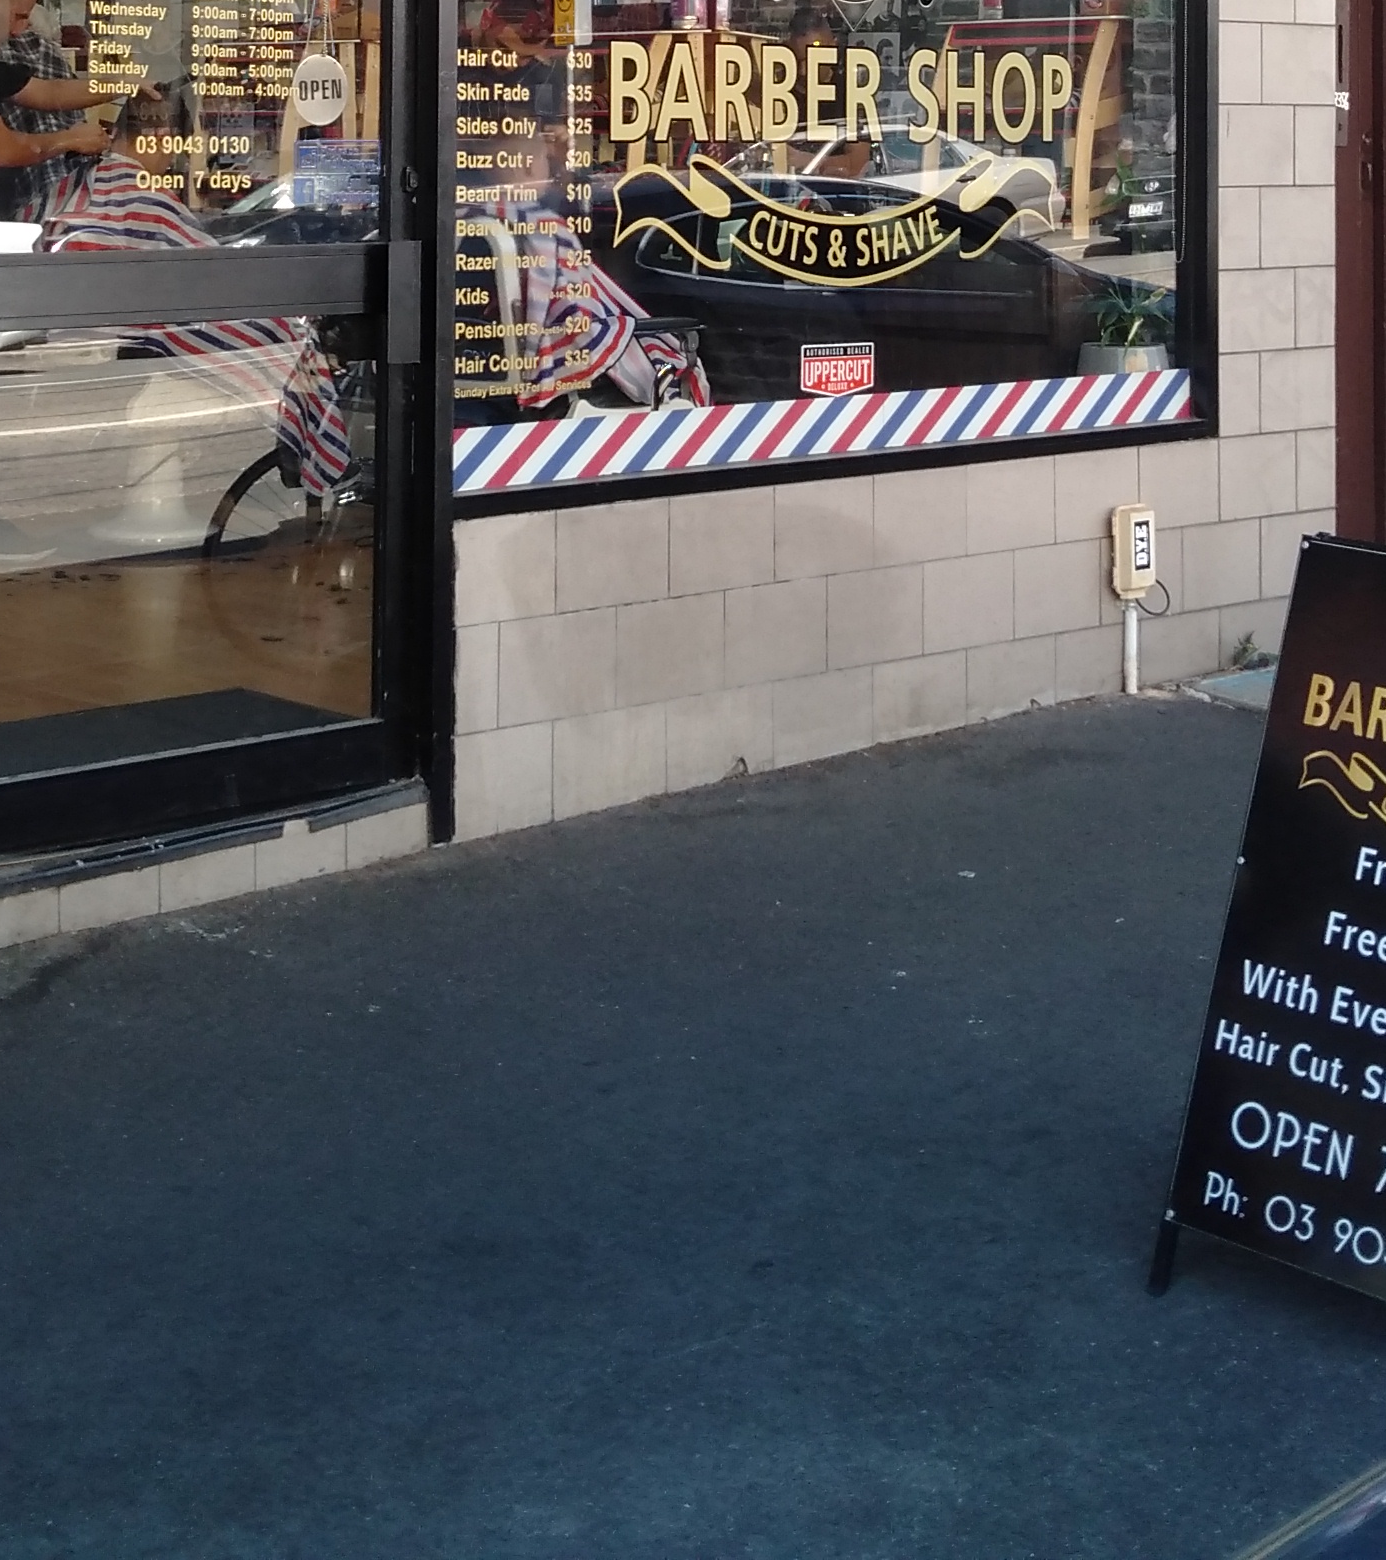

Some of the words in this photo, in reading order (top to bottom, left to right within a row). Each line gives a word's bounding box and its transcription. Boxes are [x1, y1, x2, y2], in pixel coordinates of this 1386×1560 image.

[90, 1, 166, 21] Wednesday
[90, 21, 152, 39] Thursday
[90, 40, 131, 56] Friday
[457, 49, 488, 67] Hair
[492, 50, 518, 67] Cut
[566, 52, 592, 69] $30
[90, 60, 148, 78] Saturday
[192, 63, 237, 77] 9:00am
[249, 64, 293, 80] 5:00pm
[89, 80, 139, 97] Sunday
[192, 83, 244, 96] 10:00am
[255, 84, 300, 100] 4:00pm
[299, 79, 342, 101] OPEN
[456, 83, 489, 101] Skin
[494, 83, 530, 101] Fade
[567, 85, 592, 103] $35
[609, 40, 881, 144] BARBER
[908, 49, 1074, 144] SHOP
[456, 117, 498, 134] Sides
[502, 117, 536, 138] Only
[567, 117, 592, 135] $25
[136, 135, 156, 154] 03
[163, 136, 203, 156] 9043
[209, 136, 250, 155] 0130
[456, 151, 492, 168] Buzz
[497, 151, 523, 168] Cut
[566, 150, 591, 168] $20
[136, 171, 184, 192] Open
[195, 172, 204, 188] 7
[210, 171, 252, 193] days
[456, 185, 500, 203] Beard
[504, 185, 537, 201] Trim
[567, 183, 591, 202] $10
[748, 210, 819, 267] CUTS
[827, 238, 847, 268] &
[856, 204, 944, 267] SHAVE
[455, 288, 489, 305] Kids
[566, 283, 591, 299] $20
[455, 320, 538, 340] Pensioners
[565, 316, 590, 335] $20
[806, 347, 844, 356] AUTHORISED
[847, 346, 870, 355] DEALER
[455, 357, 486, 374] Hair
[489, 354, 539, 372] Colour
[565, 350, 590, 366] $35
[804, 359, 870, 386] UPPERCUT
[1243, 959, 1318, 1014] With
[1215, 1019, 1280, 1067] Hair
[1289, 1043, 1350, 1093] Cut,
[1231, 1101, 1355, 1181] OPEN
[1203, 1171, 1249, 1219] Ph:
[1264, 1196, 1315, 1241] 03
